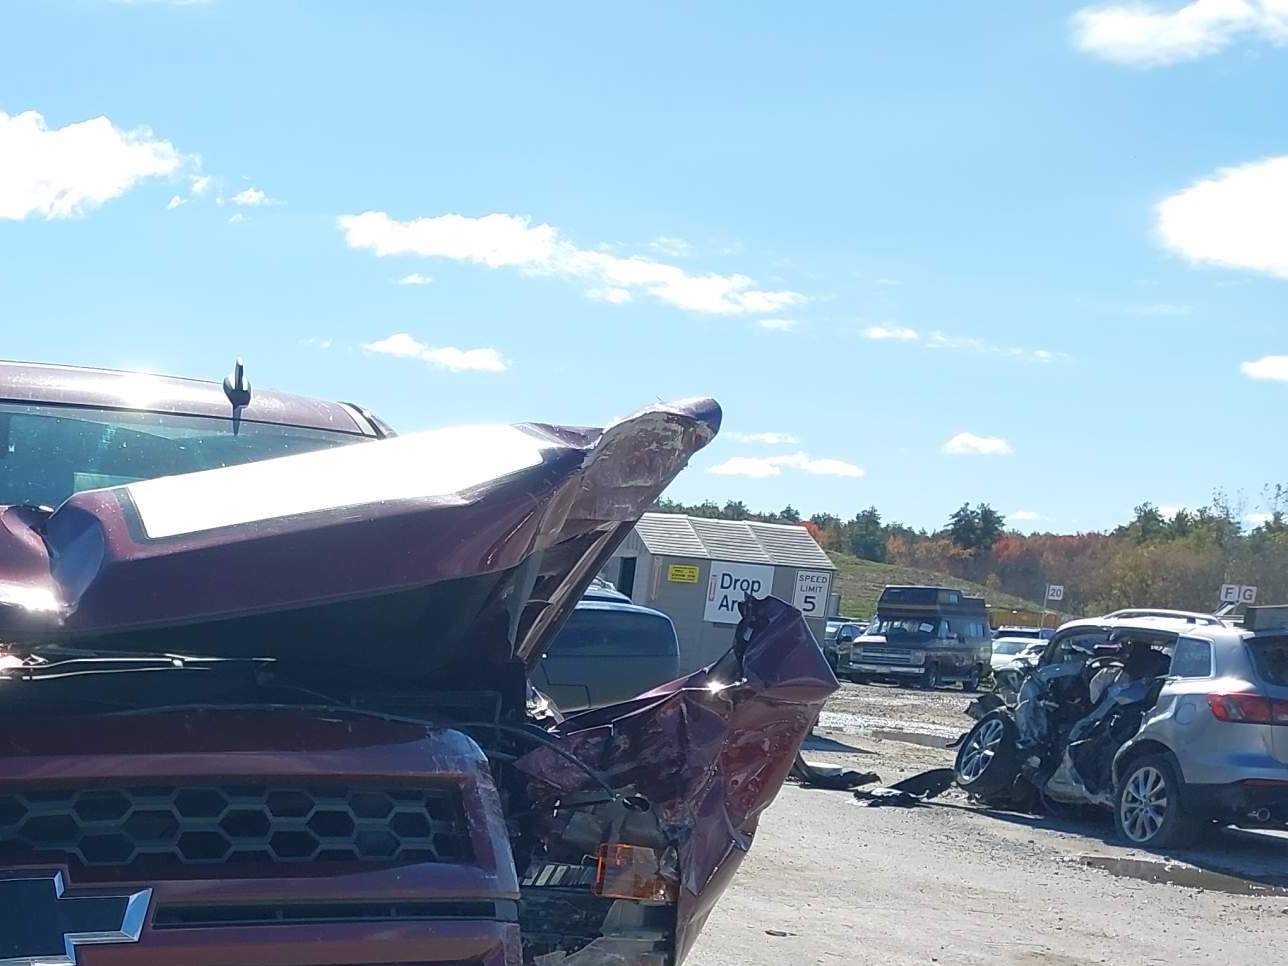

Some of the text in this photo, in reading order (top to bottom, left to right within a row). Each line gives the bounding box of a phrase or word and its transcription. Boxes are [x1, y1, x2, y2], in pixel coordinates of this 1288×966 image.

[720, 573, 761, 595] Drop
[799, 574, 828, 583] SPEED
[800, 584, 823, 592] LIMIT
[1225, 587, 1234, 599] F
[1242, 588, 1253, 601] G
[718, 594, 739, 612] Ar
[802, 595, 817, 612] 5
